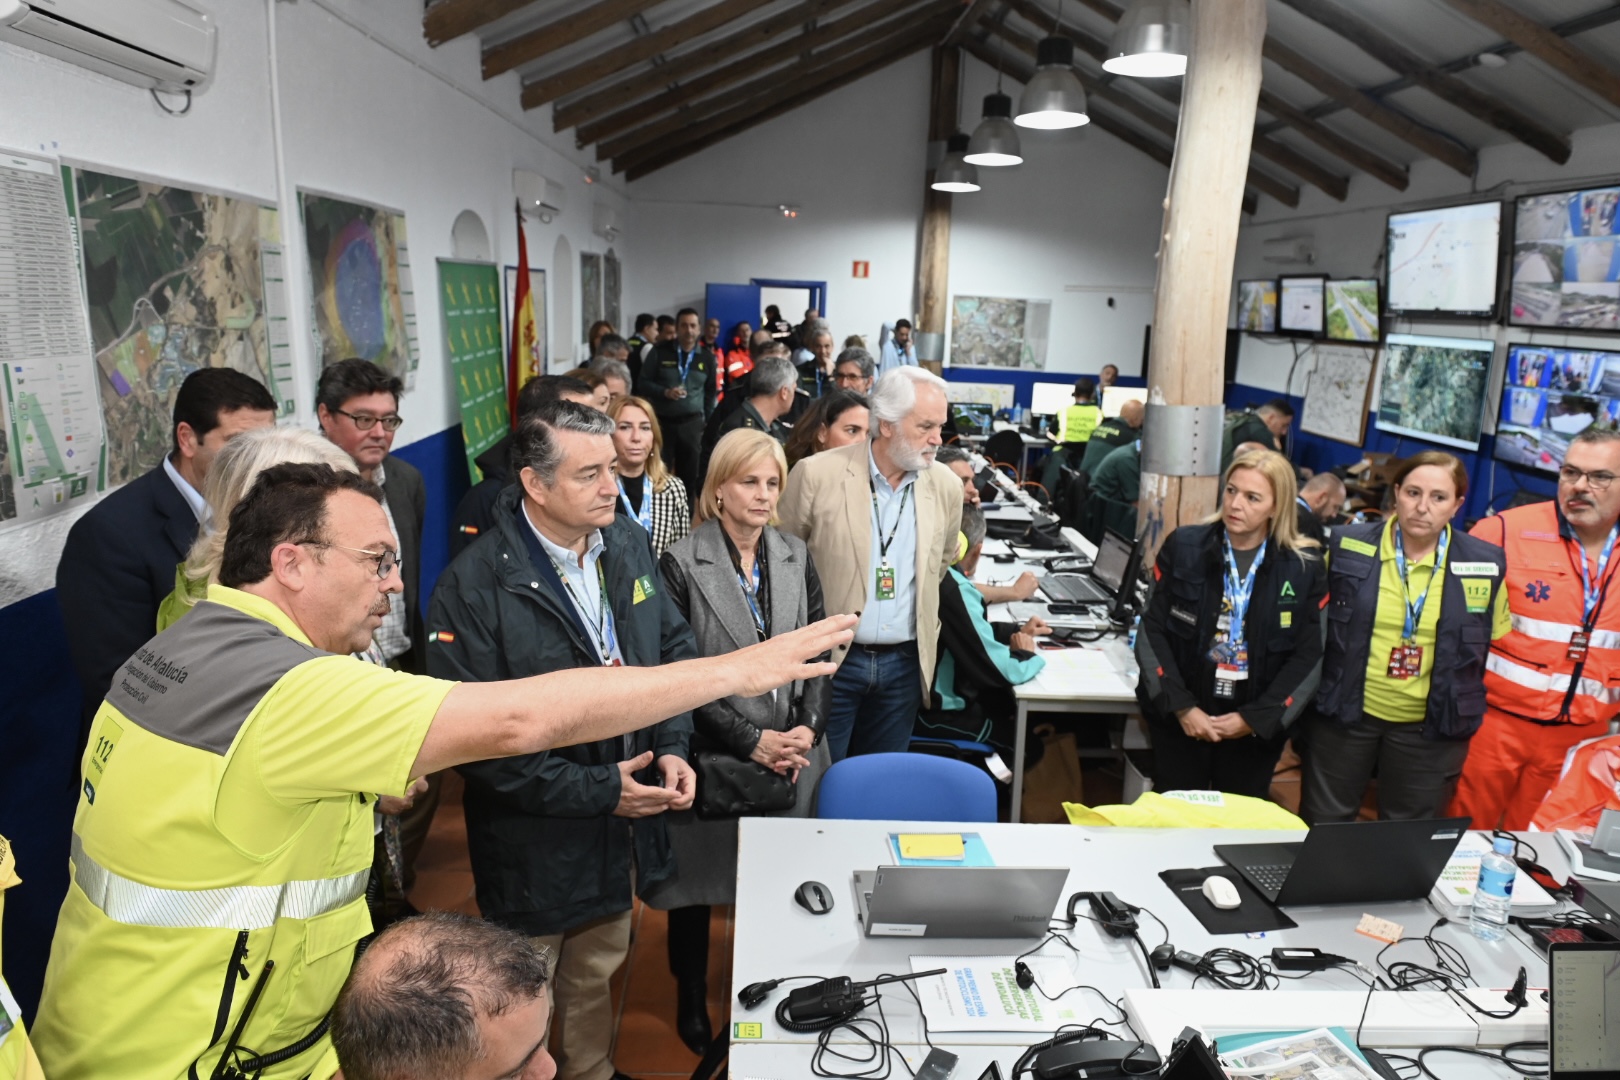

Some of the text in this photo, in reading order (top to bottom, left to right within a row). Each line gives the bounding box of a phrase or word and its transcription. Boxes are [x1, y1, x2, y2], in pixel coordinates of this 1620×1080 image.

[1467, 586, 1489, 596] 112
[96, 736, 114, 763] 112
[991, 971, 1017, 1015] DE ANDALUCÍA
[1002, 967, 1030, 1020] DE EMERGENCIAS
